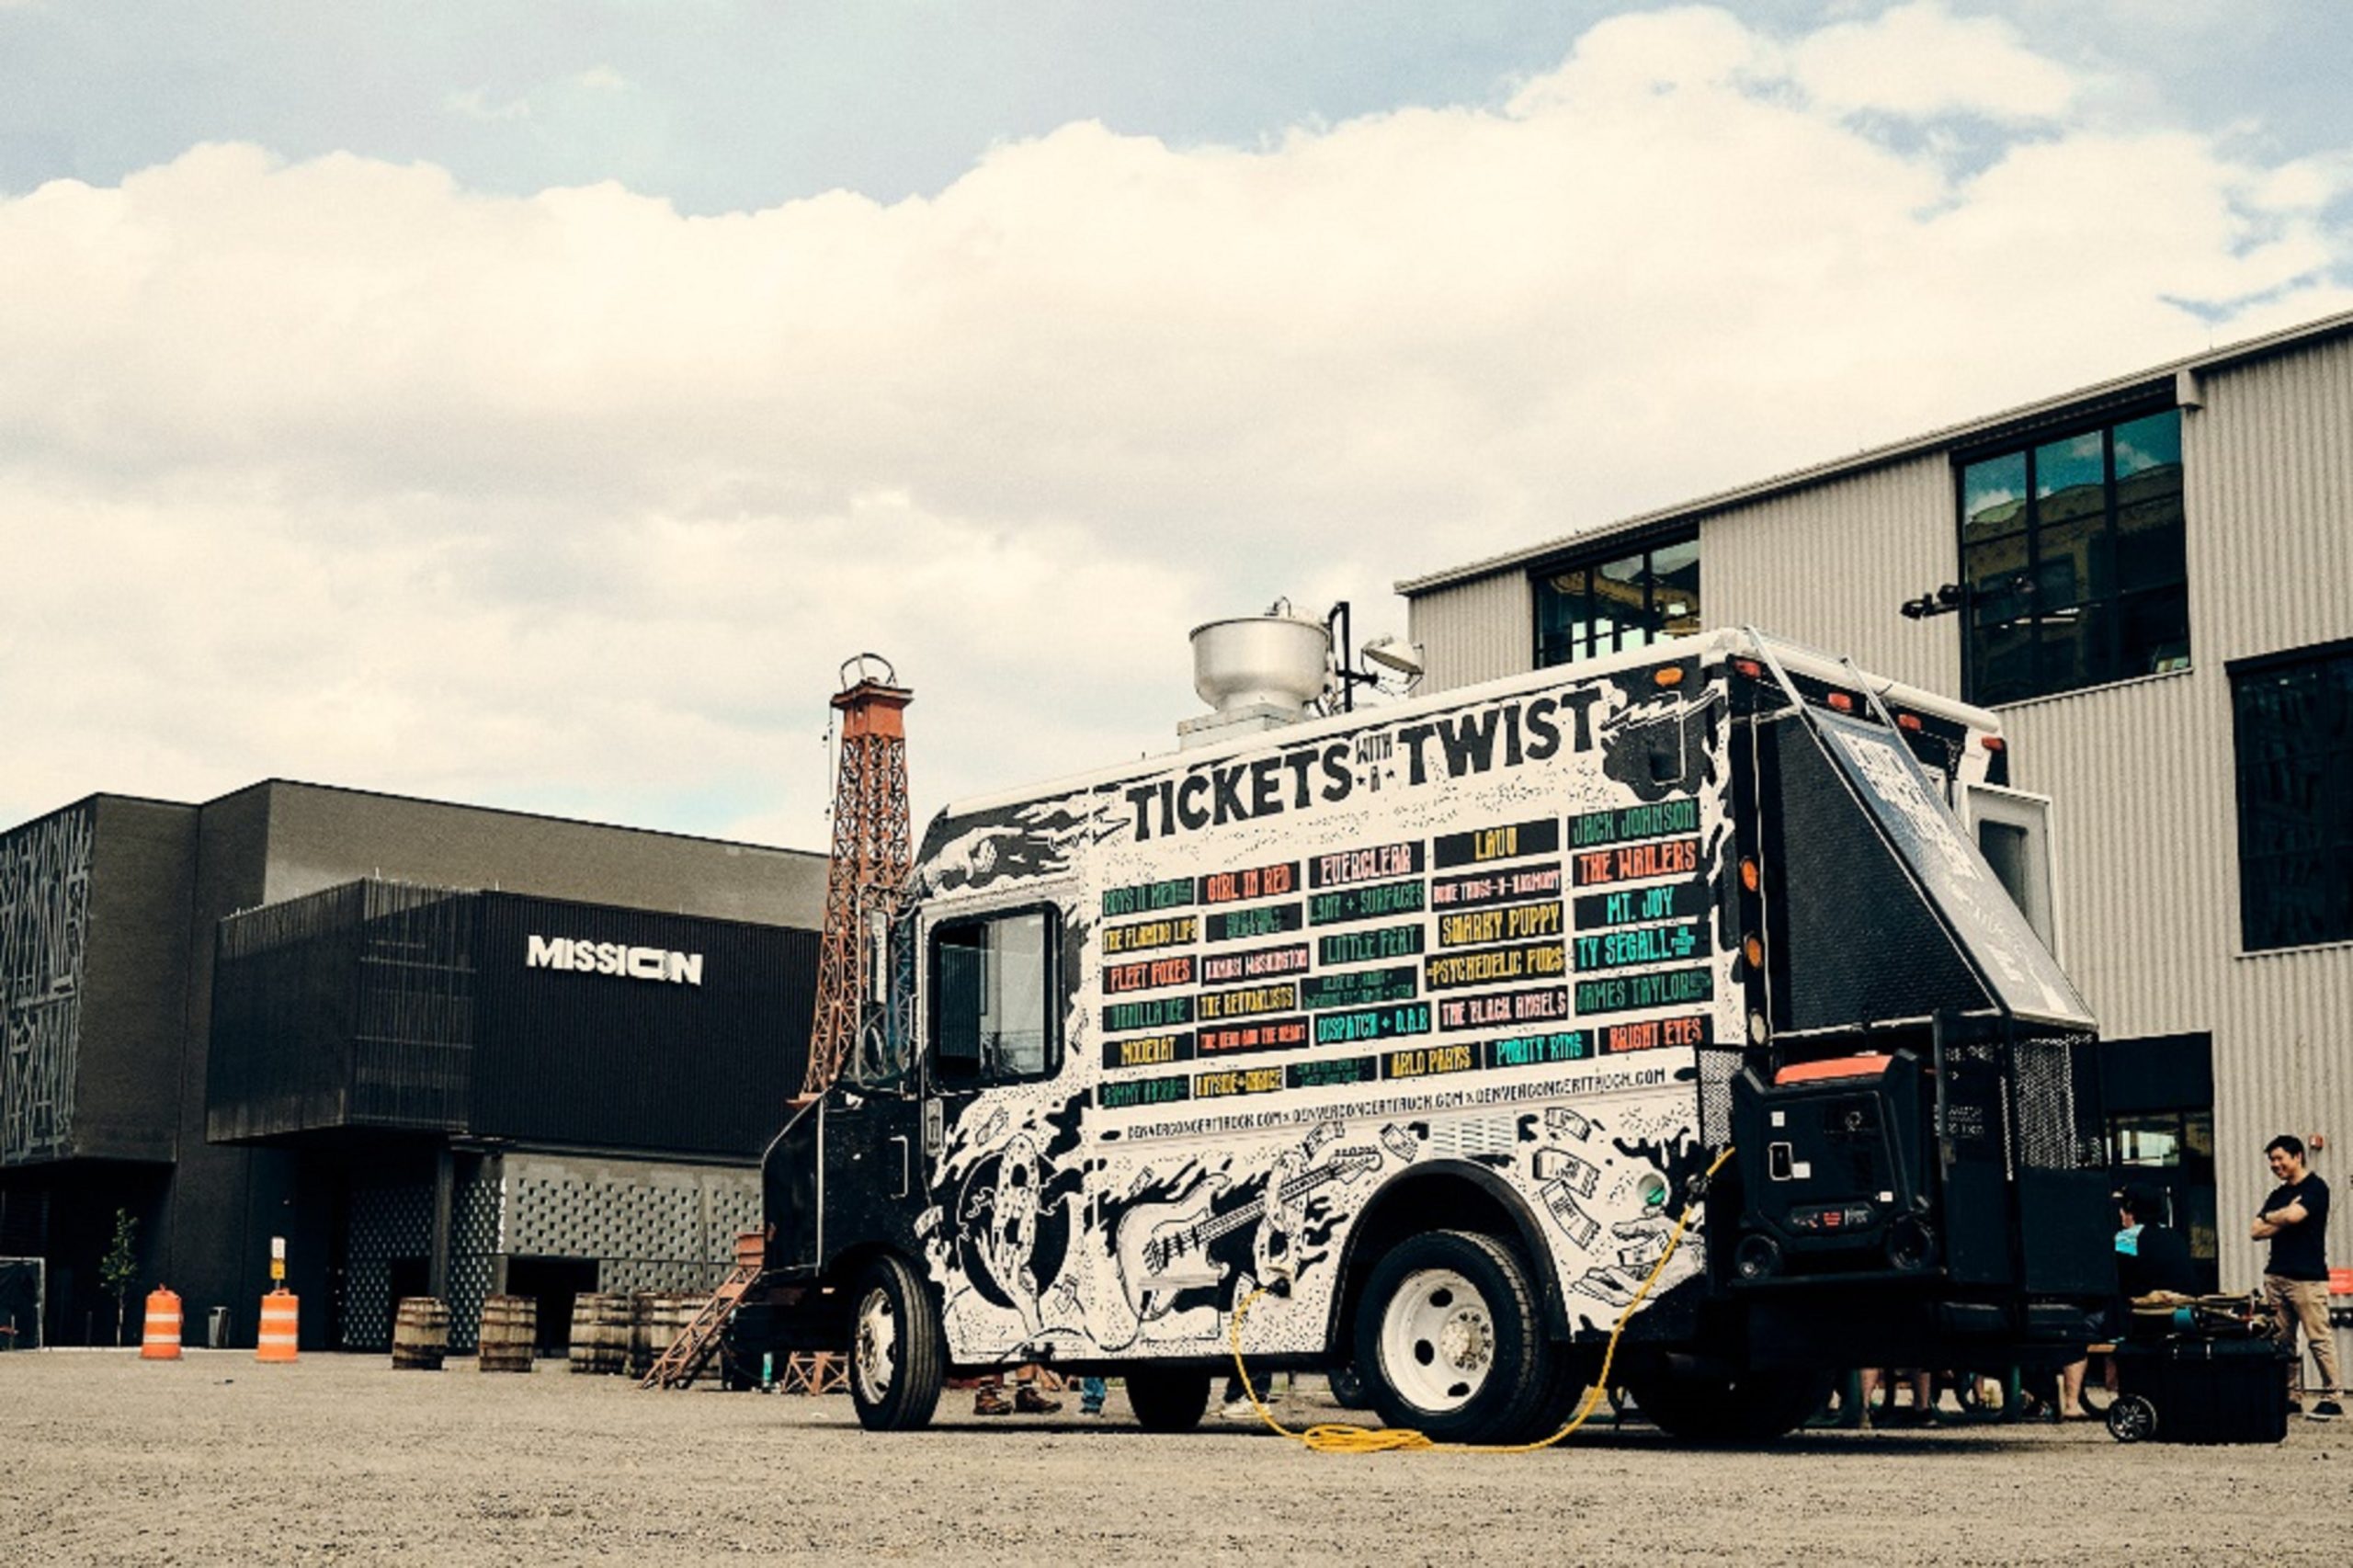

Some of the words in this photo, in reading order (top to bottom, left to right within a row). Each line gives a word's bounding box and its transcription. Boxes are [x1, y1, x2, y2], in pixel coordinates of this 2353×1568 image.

[1126, 743, 1352, 842] TICKETS
[1356, 733, 1392, 765] WITH
[1397, 687, 1601, 786] TWIST
[1574, 813, 1615, 845] JACK
[1621, 801, 1696, 838] JOHNSON
[1579, 853, 1613, 884] THE
[1618, 841, 1696, 880] WAILERS
[1207, 875, 1239, 902] GIRL
[1263, 864, 1291, 895] RED
[1508, 902, 1559, 937] PUPPY
[1607, 892, 1637, 924] MT.
[1643, 886, 1675, 918] JOY
[527, 935, 703, 986] MISSION
[1578, 937, 1599, 967] TY
[1605, 928, 1672, 965] SEGALL
[1110, 963, 1148, 993] FLEET
[1151, 958, 1190, 986] FOXES
[1318, 1013, 1378, 1042] DISPATCH
[1442, 1003, 1466, 1027] THE
